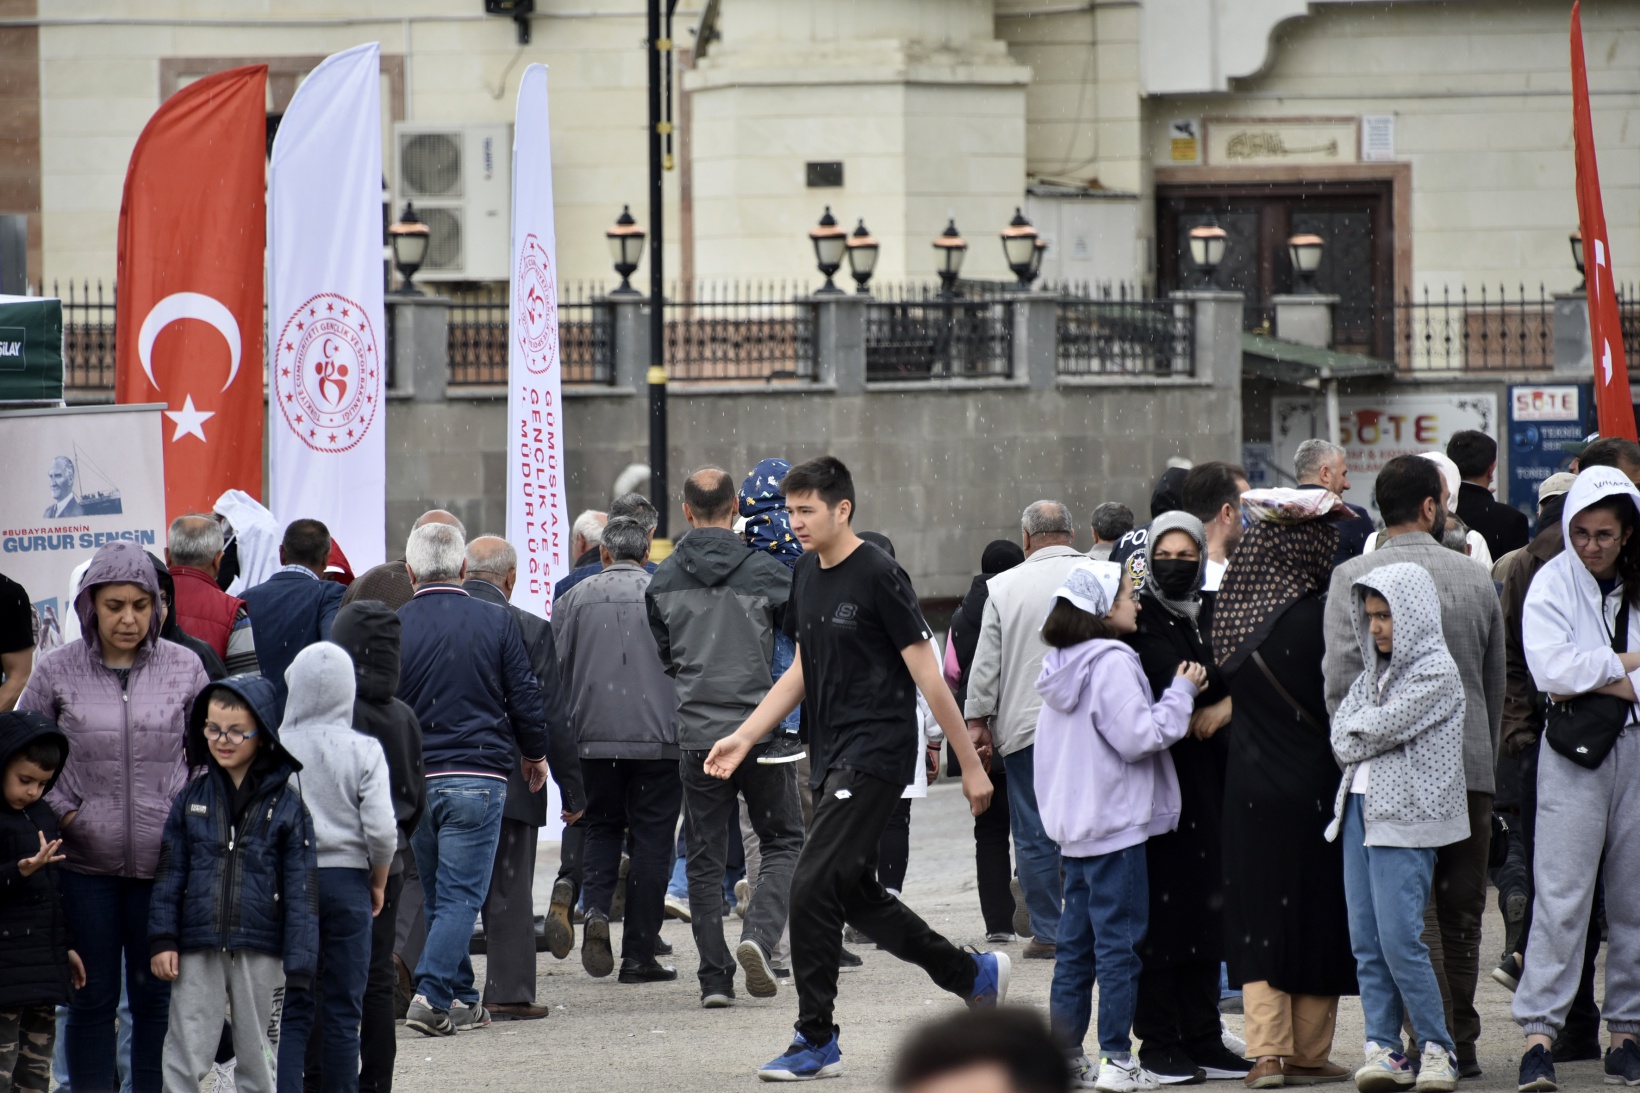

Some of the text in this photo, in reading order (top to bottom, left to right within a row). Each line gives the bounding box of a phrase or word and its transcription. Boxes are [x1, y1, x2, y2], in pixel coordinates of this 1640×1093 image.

[297, 389, 321, 422] TÜRKİYE
[320, 322, 349, 338] GENÇLİK
[350, 334, 360, 347] VE
[357, 348, 366, 374] SPOR
[2, 524, 90, 537] #BUBAYRAMSENİN
[3, 533, 75, 553] GURUR
[540, 520, 549, 552] VE
[543, 562, 552, 617] SPO
